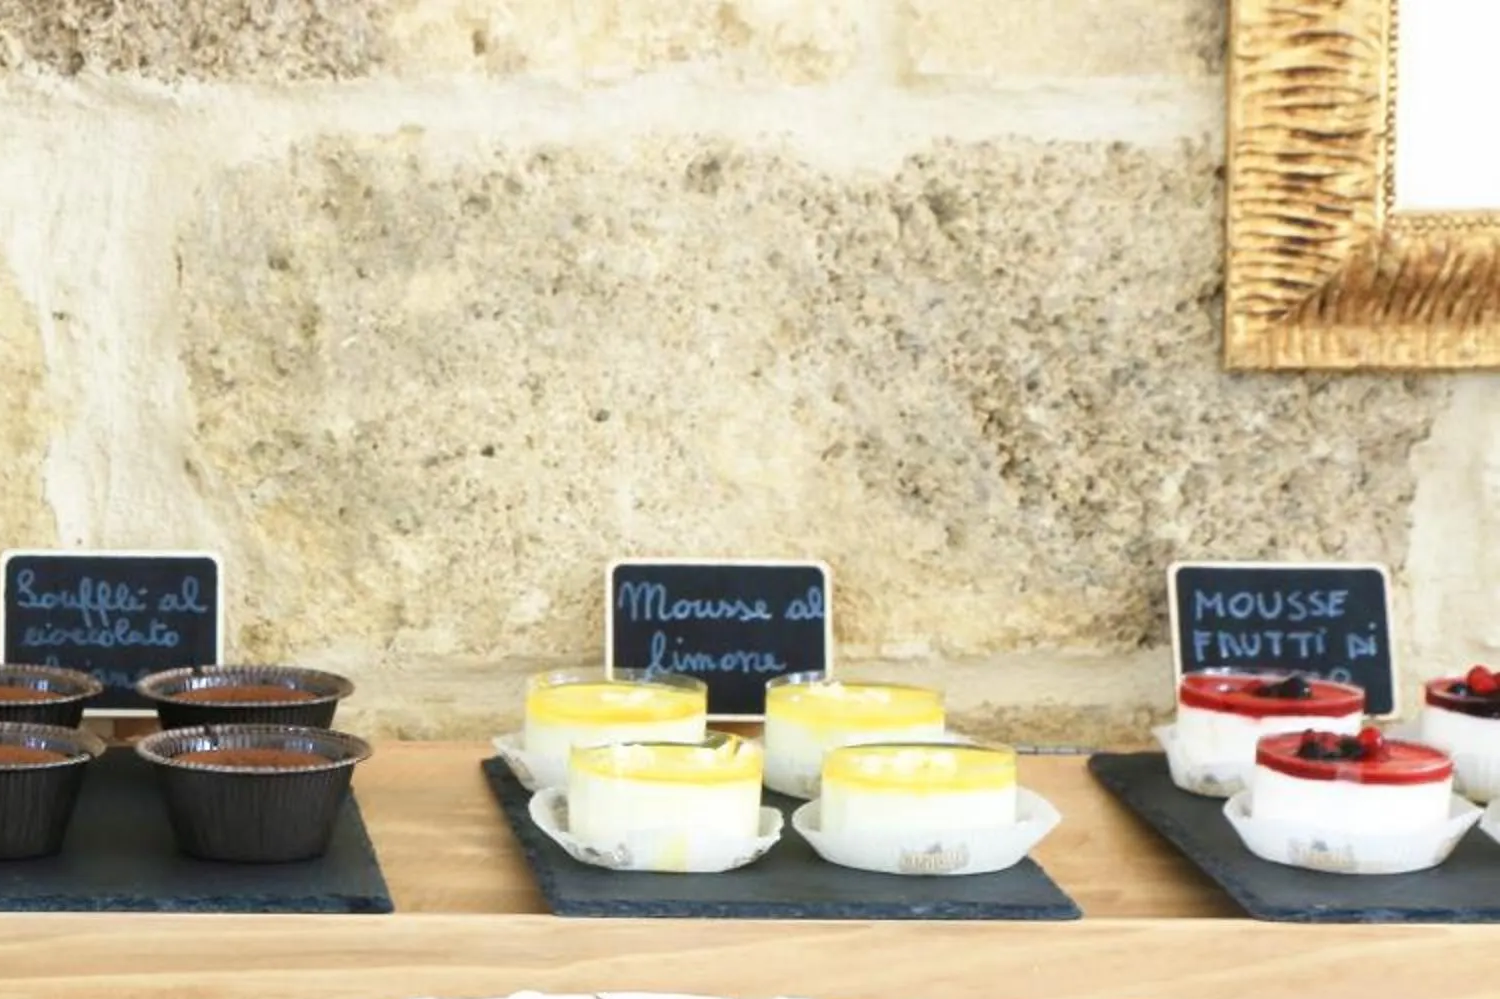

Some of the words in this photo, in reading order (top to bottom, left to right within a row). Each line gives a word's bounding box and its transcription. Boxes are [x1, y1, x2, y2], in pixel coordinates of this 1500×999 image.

[158, 575, 209, 613] al
[617, 580, 773, 622] Mousse
[784, 585, 825, 621] al
[1194, 588, 1349, 622] MOUSSE
[21, 617, 181, 648] cioccolato
[643, 630, 788, 681] limone
